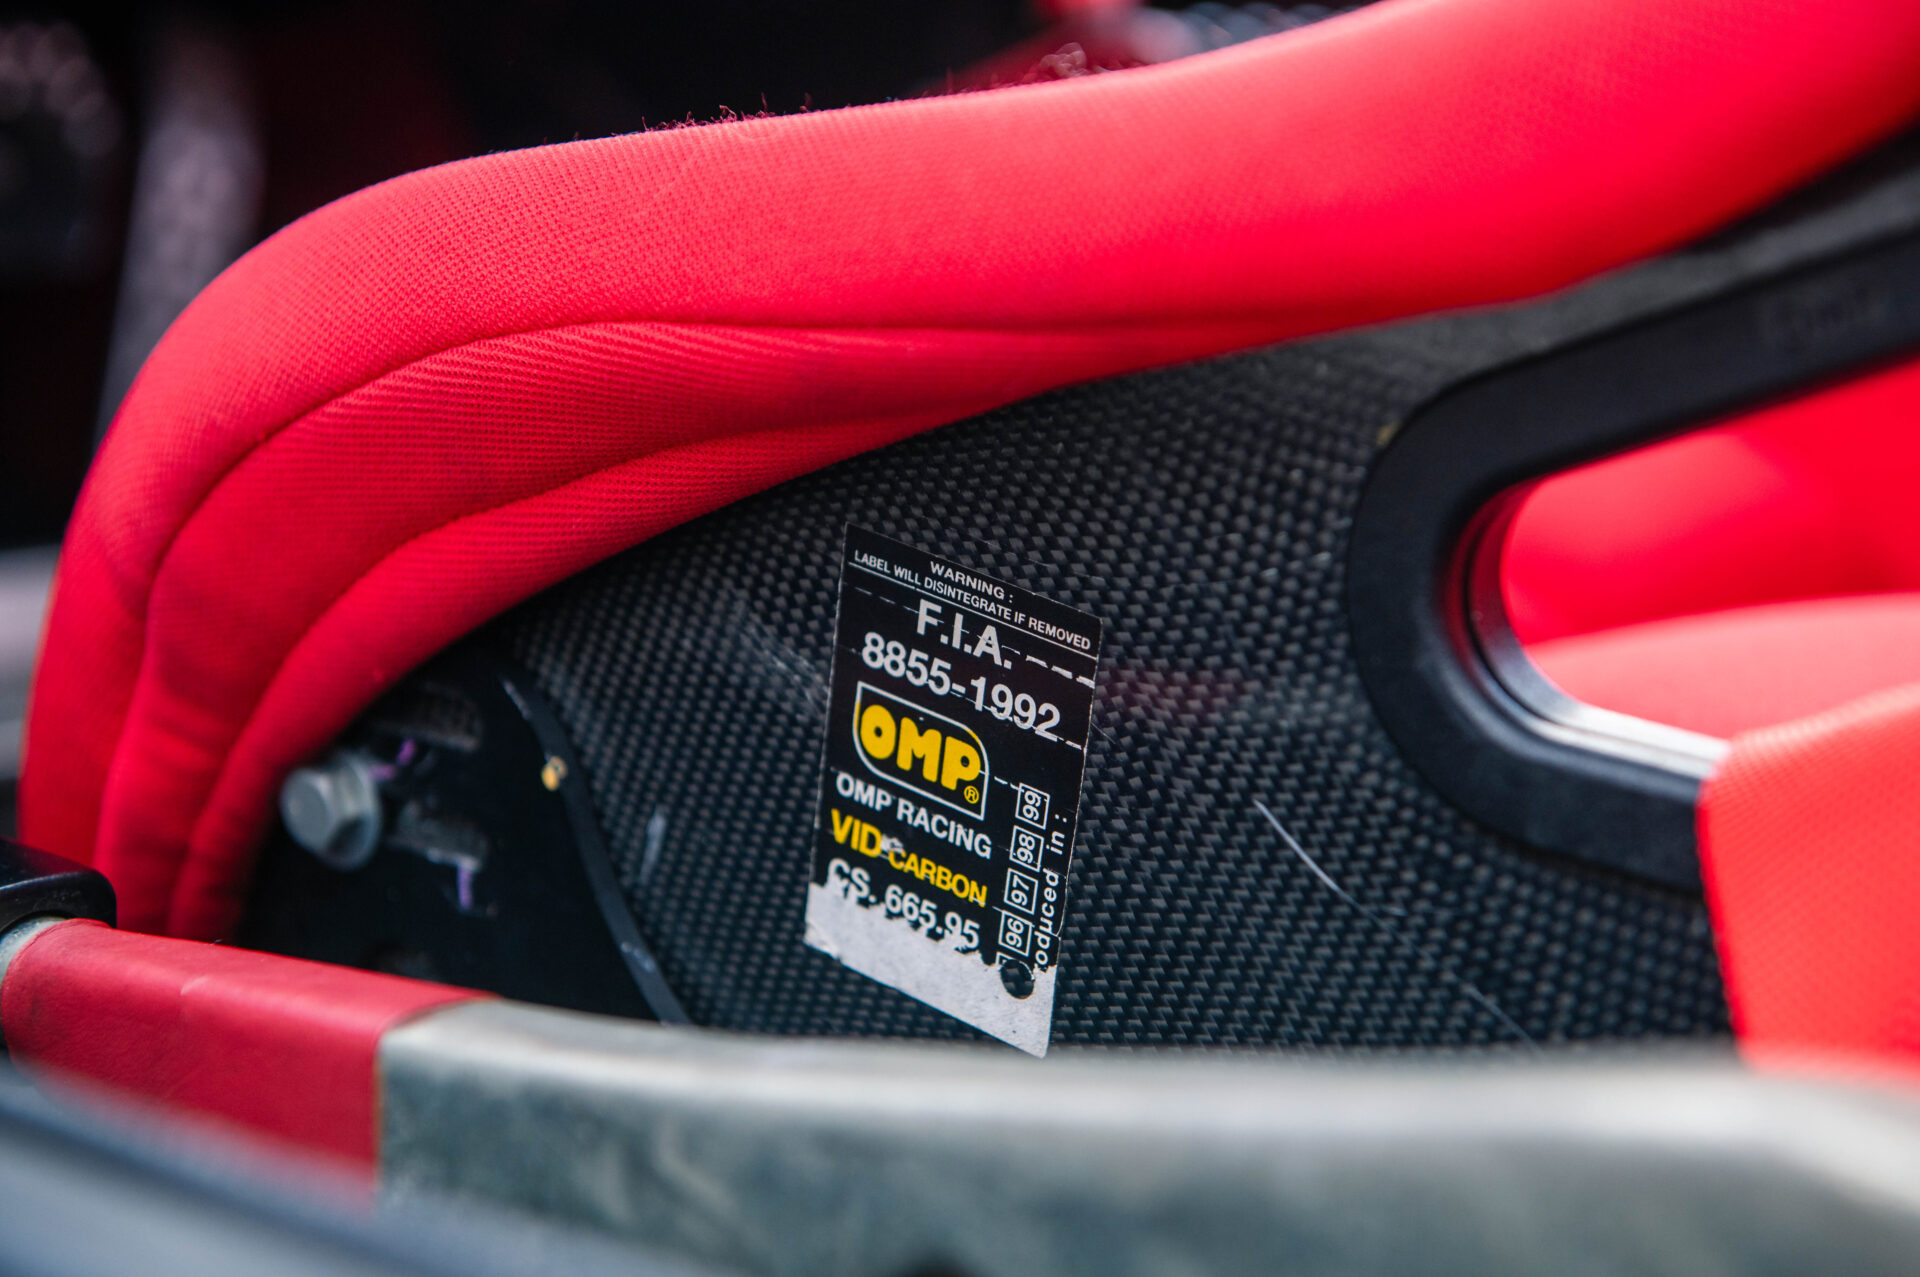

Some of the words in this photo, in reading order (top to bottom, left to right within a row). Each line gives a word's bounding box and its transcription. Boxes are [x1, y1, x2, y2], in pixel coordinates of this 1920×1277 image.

[854, 549, 891, 574] LABEL
[893, 564, 921, 586] WILL
[924, 577, 1012, 620] DISINTEGRATE
[1014, 611, 1026, 625] IF
[1028, 617, 1091, 650] REMOVED
[930, 561, 1004, 601] WARNING
[917, 599, 1012, 670] F.I.A.
[862, 632, 1061, 742] 8855-1992
[860, 704, 981, 790] OMP
[836, 772, 892, 811] OMP
[897, 797, 992, 859] RACING
[1022, 791, 1042, 821] 99
[831, 808, 882, 858] VID
[889, 848, 988, 907] CARBON
[1017, 833, 1036, 864] 98
[1046, 830, 1065, 855] in
[885, 884, 980, 949] 665.95
[1012, 875, 1030, 907] 97
[1005, 918, 1024, 949] 96
